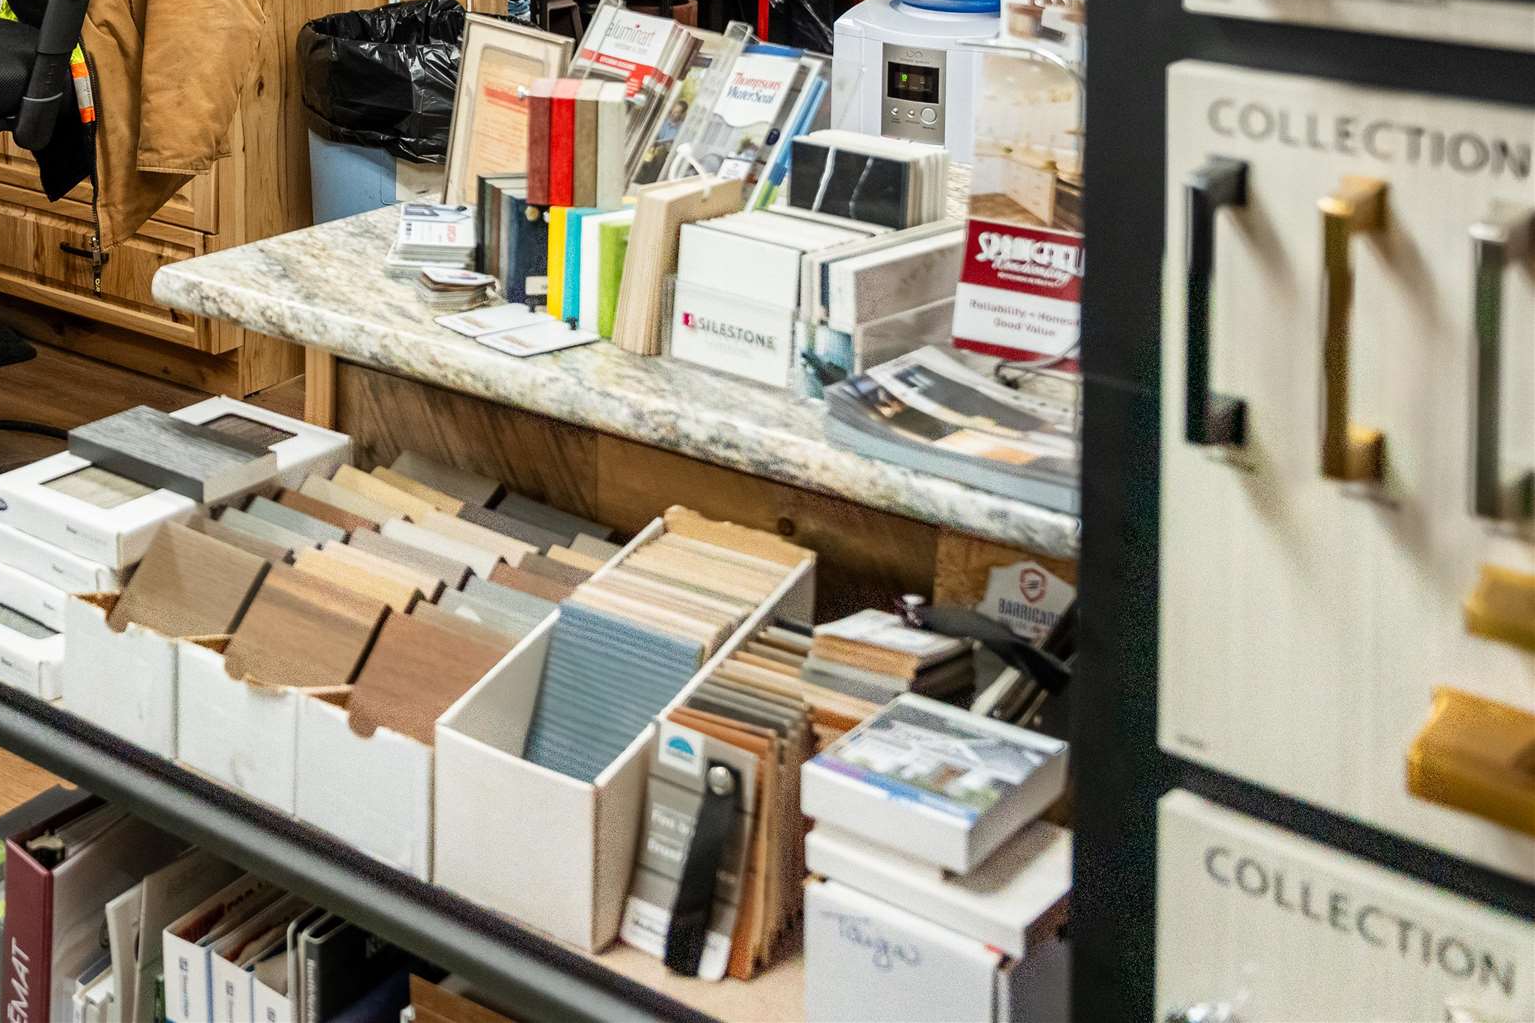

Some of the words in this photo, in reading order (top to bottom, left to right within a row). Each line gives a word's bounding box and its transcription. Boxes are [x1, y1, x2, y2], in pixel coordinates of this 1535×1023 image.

[1207, 97, 1531, 180] COLLECTION
[698, 317, 776, 350] SILESTONE
[998, 598, 1057, 626] BARRICAD
[1204, 844, 1516, 997] COLLECTION
